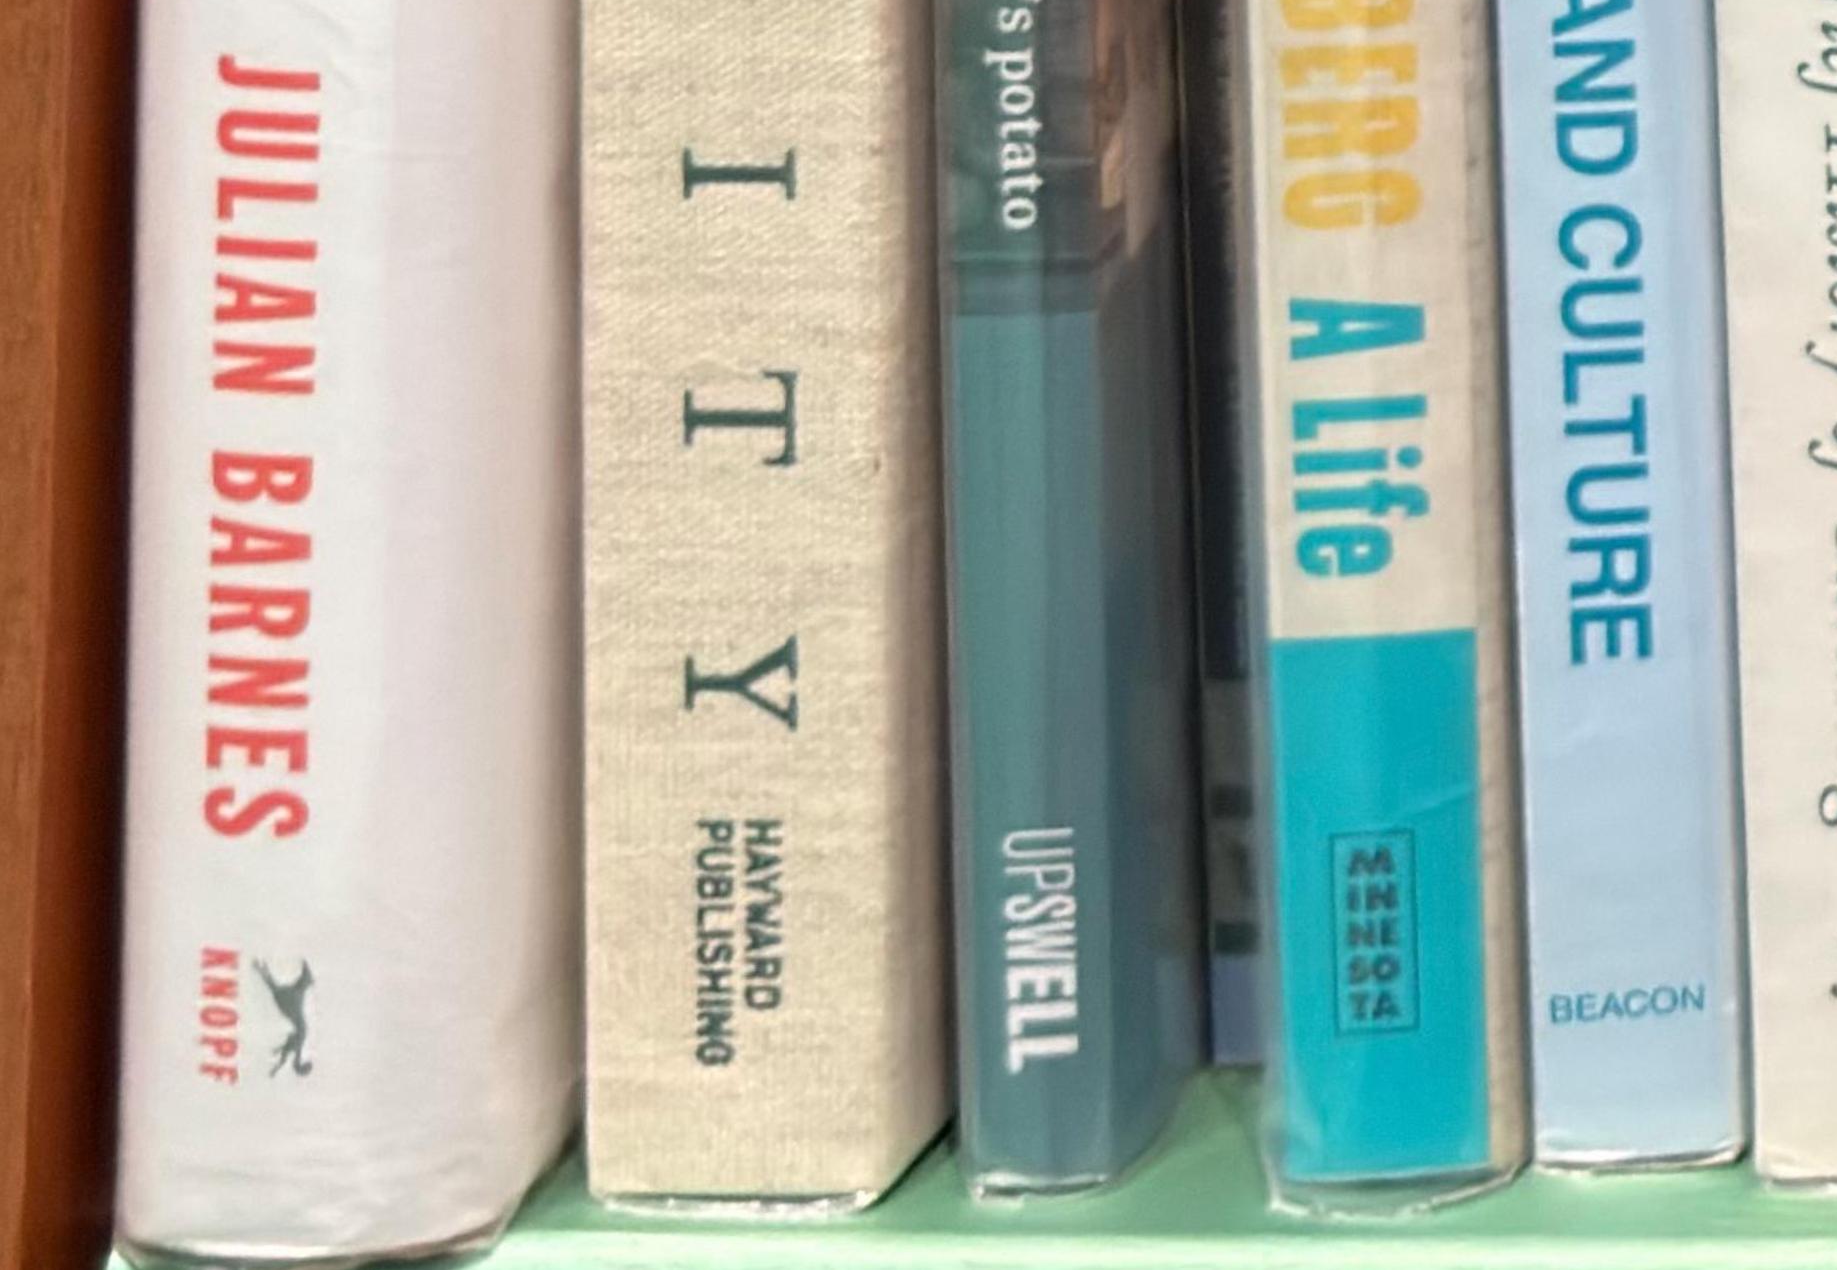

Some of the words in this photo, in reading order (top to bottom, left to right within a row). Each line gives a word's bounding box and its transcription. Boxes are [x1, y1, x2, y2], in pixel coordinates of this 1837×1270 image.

[213, 54, 321, 398] JULIAN
[1289, 298, 1427, 360] A
[1290, 396, 1430, 577] Life
[1559, 202, 1655, 664] CULTURE
[205, 449, 314, 838] BARNES
[199, 947, 242, 1086] KNOPF
[696, 818, 736, 1067] PUBLISHING
[744, 818, 783, 1010] HAYWARD
[1003, 826, 1078, 1071] UPSWELL
[1551, 984, 1705, 1023] BEACON
